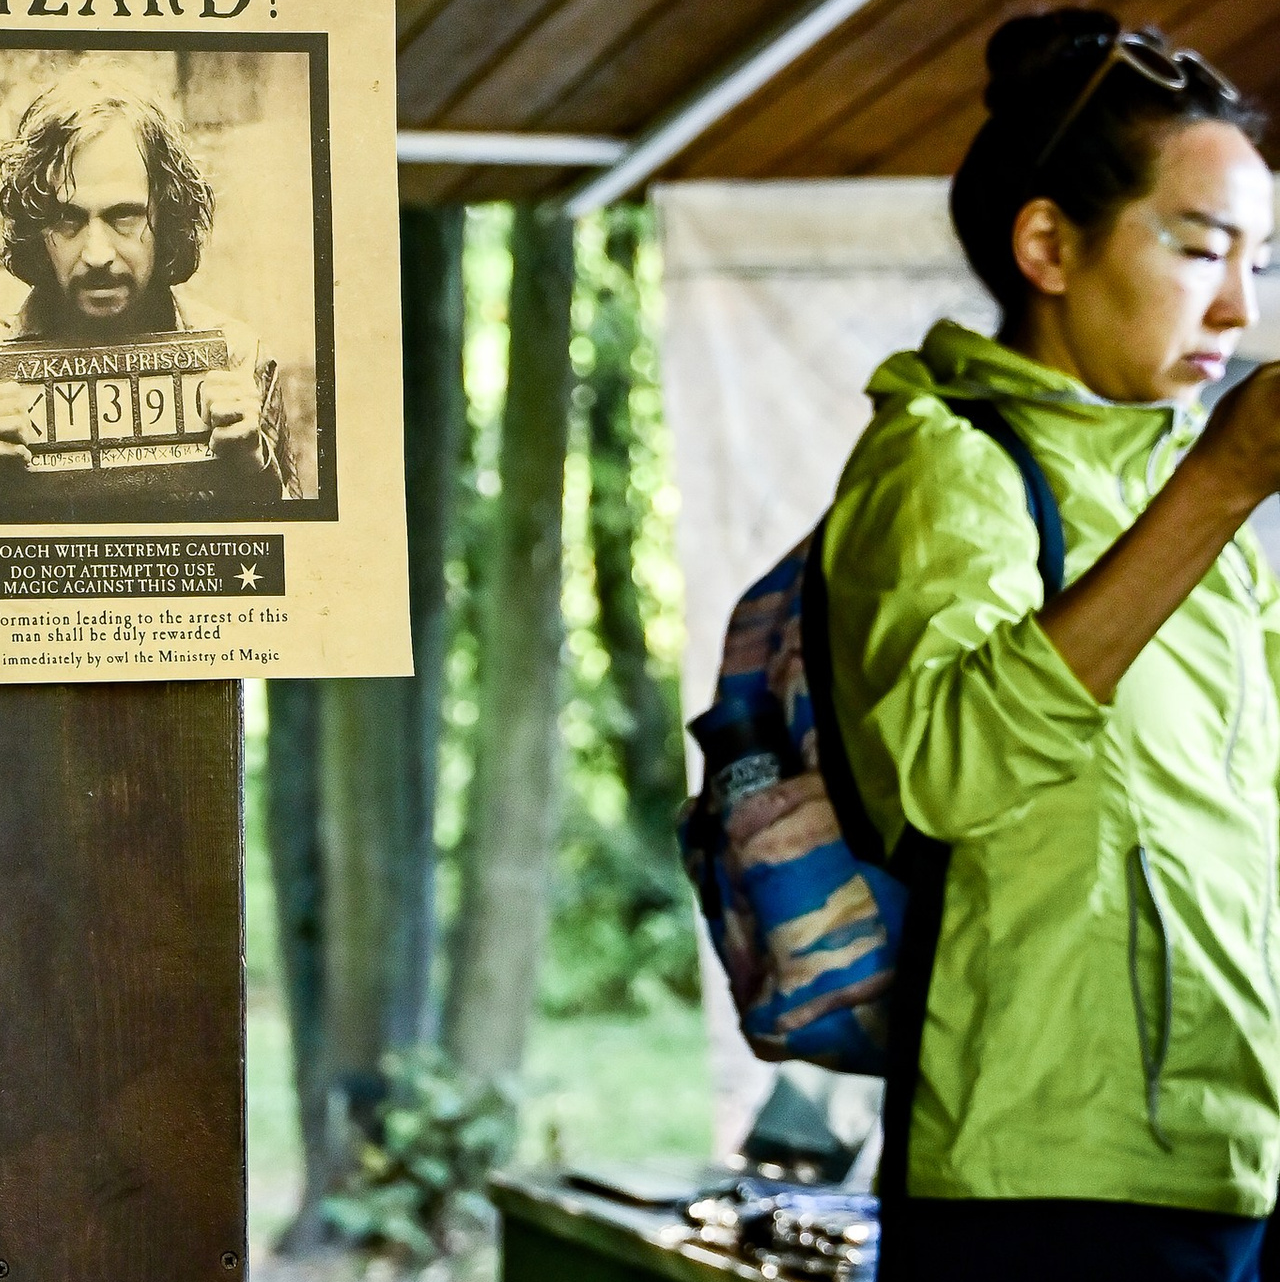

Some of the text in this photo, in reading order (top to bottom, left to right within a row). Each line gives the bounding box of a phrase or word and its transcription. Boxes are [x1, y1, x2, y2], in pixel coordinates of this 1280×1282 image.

[14, 348, 210, 380] AZKABAN PRISON
[54, 543, 99, 558] WITH
[104, 542, 181, 557] EXTREME
[185, 541, 270, 556] CAUTION!
[10, 562, 216, 579] DO NOT ATTEMPT TO USE
[3, 578, 223, 594] MAGIC AGAINST THIS MAN!
[76, 610, 132, 629] leading
[137, 613, 153, 624] to
[159, 609, 183, 624] the
[189, 612, 232, 623] arrest
[238, 608, 254, 623] of
[259, 608, 288, 623] this
[11, 625, 221, 646] man shall be duly rewarded
[2, 651, 82, 668] immediately
[87, 652, 102, 668] by
[106, 651, 129, 664] owl
[134, 651, 154, 663] the
[159, 650, 216, 666] Ministry
[221, 649, 235, 661] of
[239, 649, 280, 664] Magic
